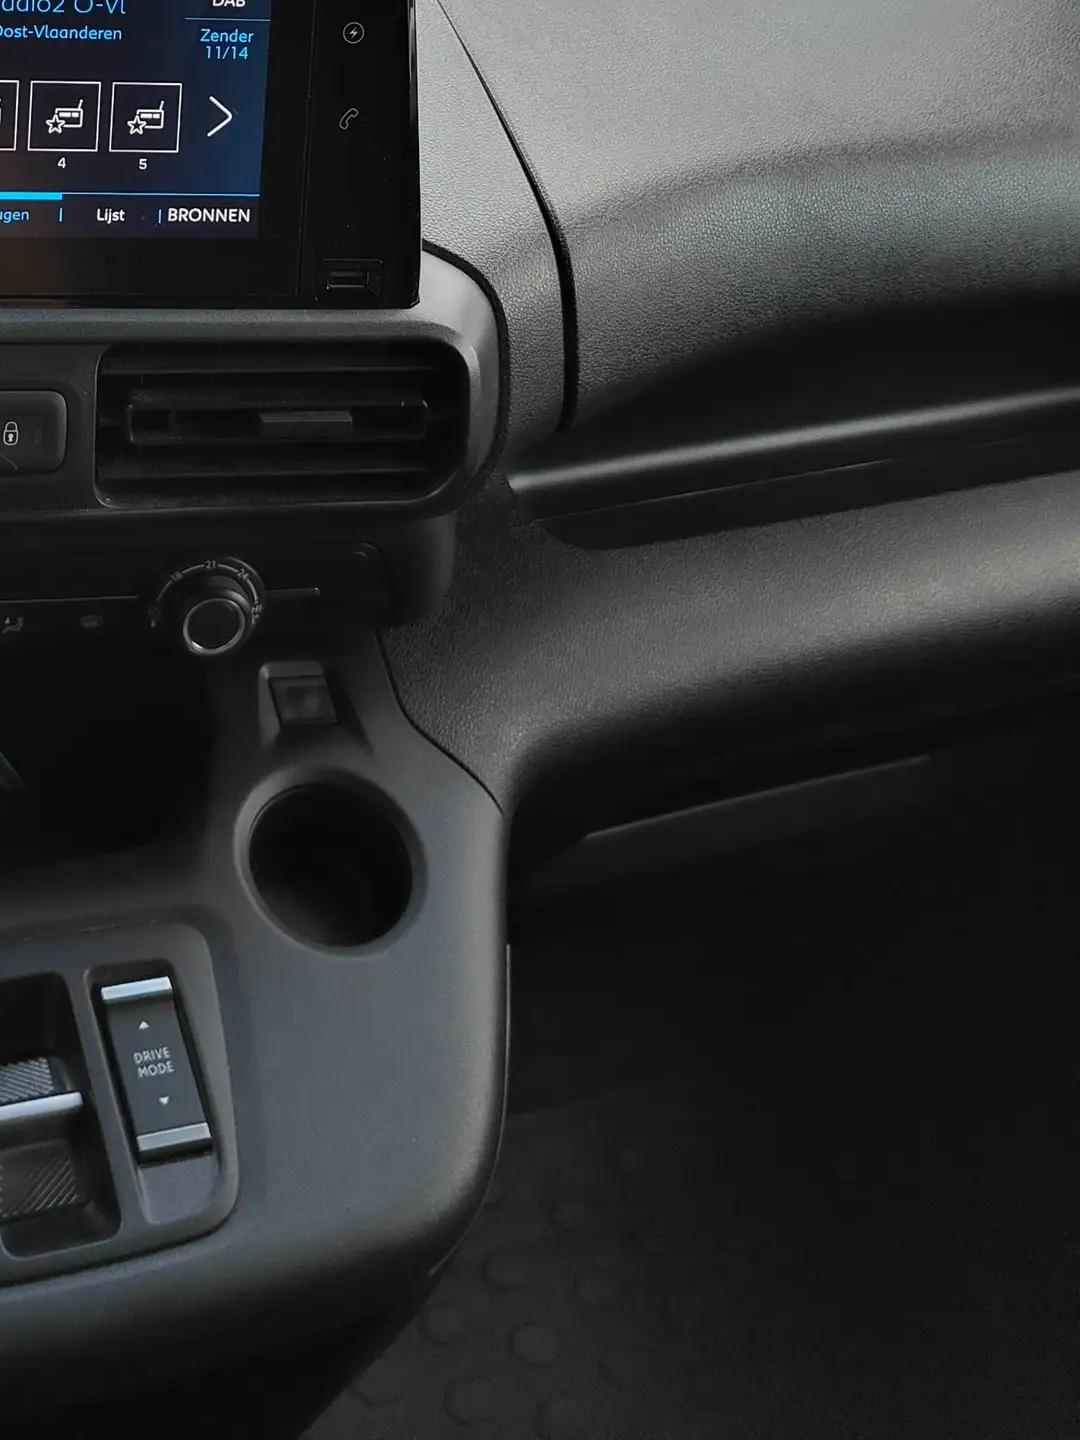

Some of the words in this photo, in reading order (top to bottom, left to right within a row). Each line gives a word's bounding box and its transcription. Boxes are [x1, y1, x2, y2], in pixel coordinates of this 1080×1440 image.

[200, 28, 254, 43] Zender
[206, 46, 249, 60] 11/14
[57, 157, 67, 169] 4
[139, 158, 148, 170] 5
[96, 208, 125, 223] Lijst
[168, 208, 251, 223] BRONNEN
[133, 1046, 171, 1064] DRIVE
[137, 1060, 175, 1079] MODE
